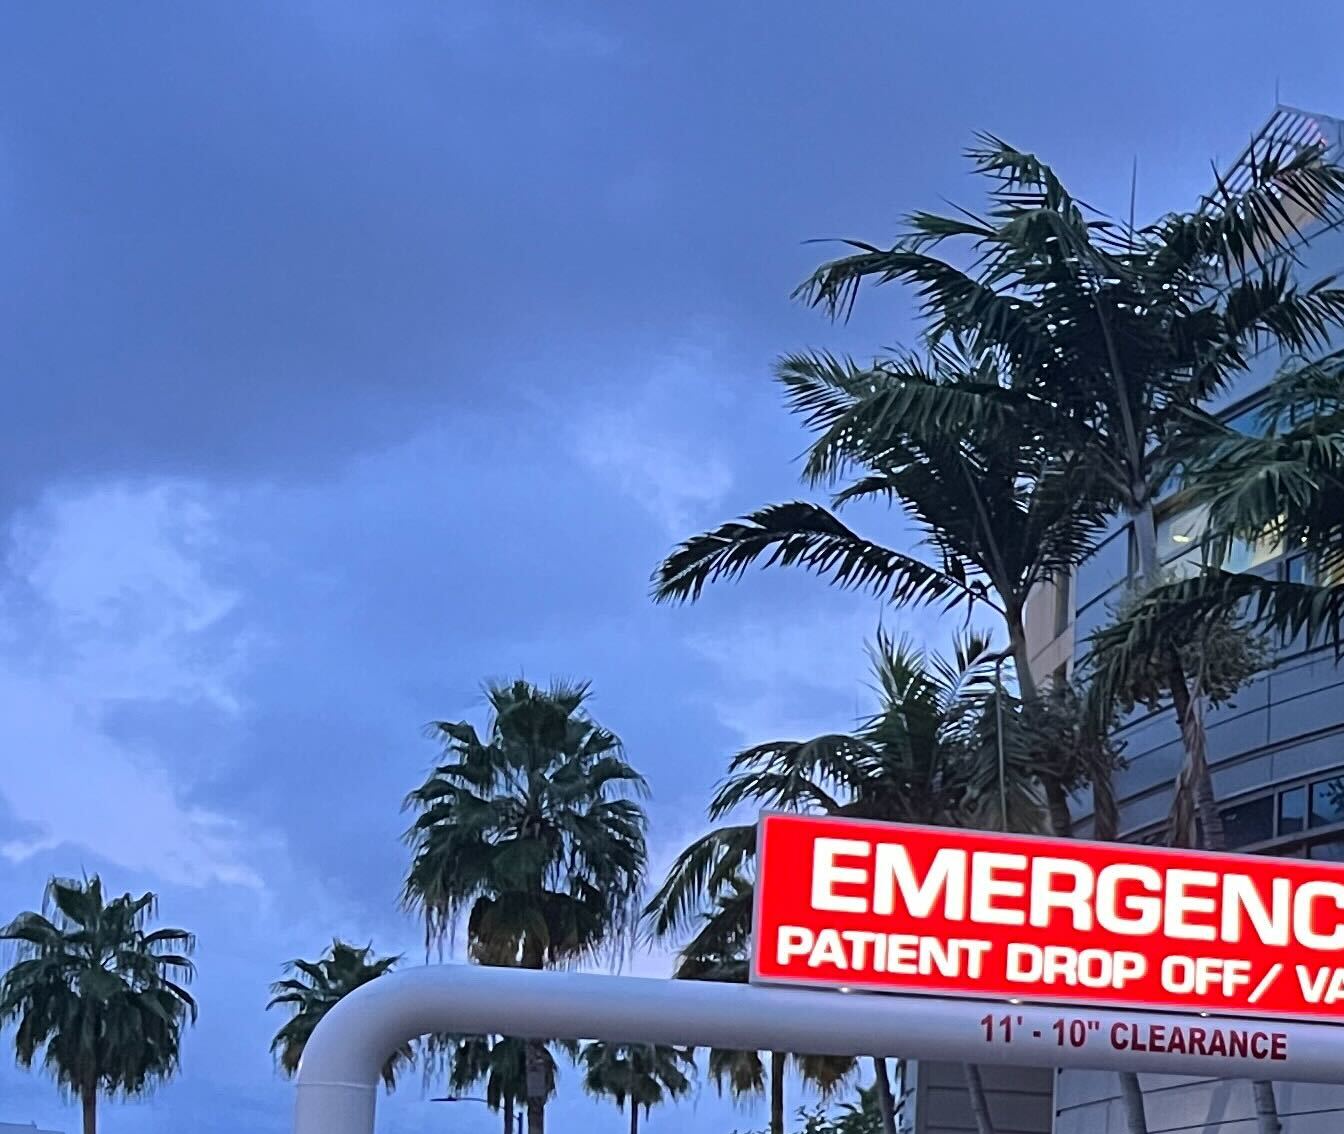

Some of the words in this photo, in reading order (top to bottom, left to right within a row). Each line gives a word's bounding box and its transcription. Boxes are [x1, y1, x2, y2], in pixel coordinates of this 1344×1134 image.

[776, 925, 992, 980] PATIENT
[1005, 943, 1147, 989] DROP
[981, 1013, 1023, 1044] 11'
[1110, 1021, 1288, 1061] CLEARANCE
